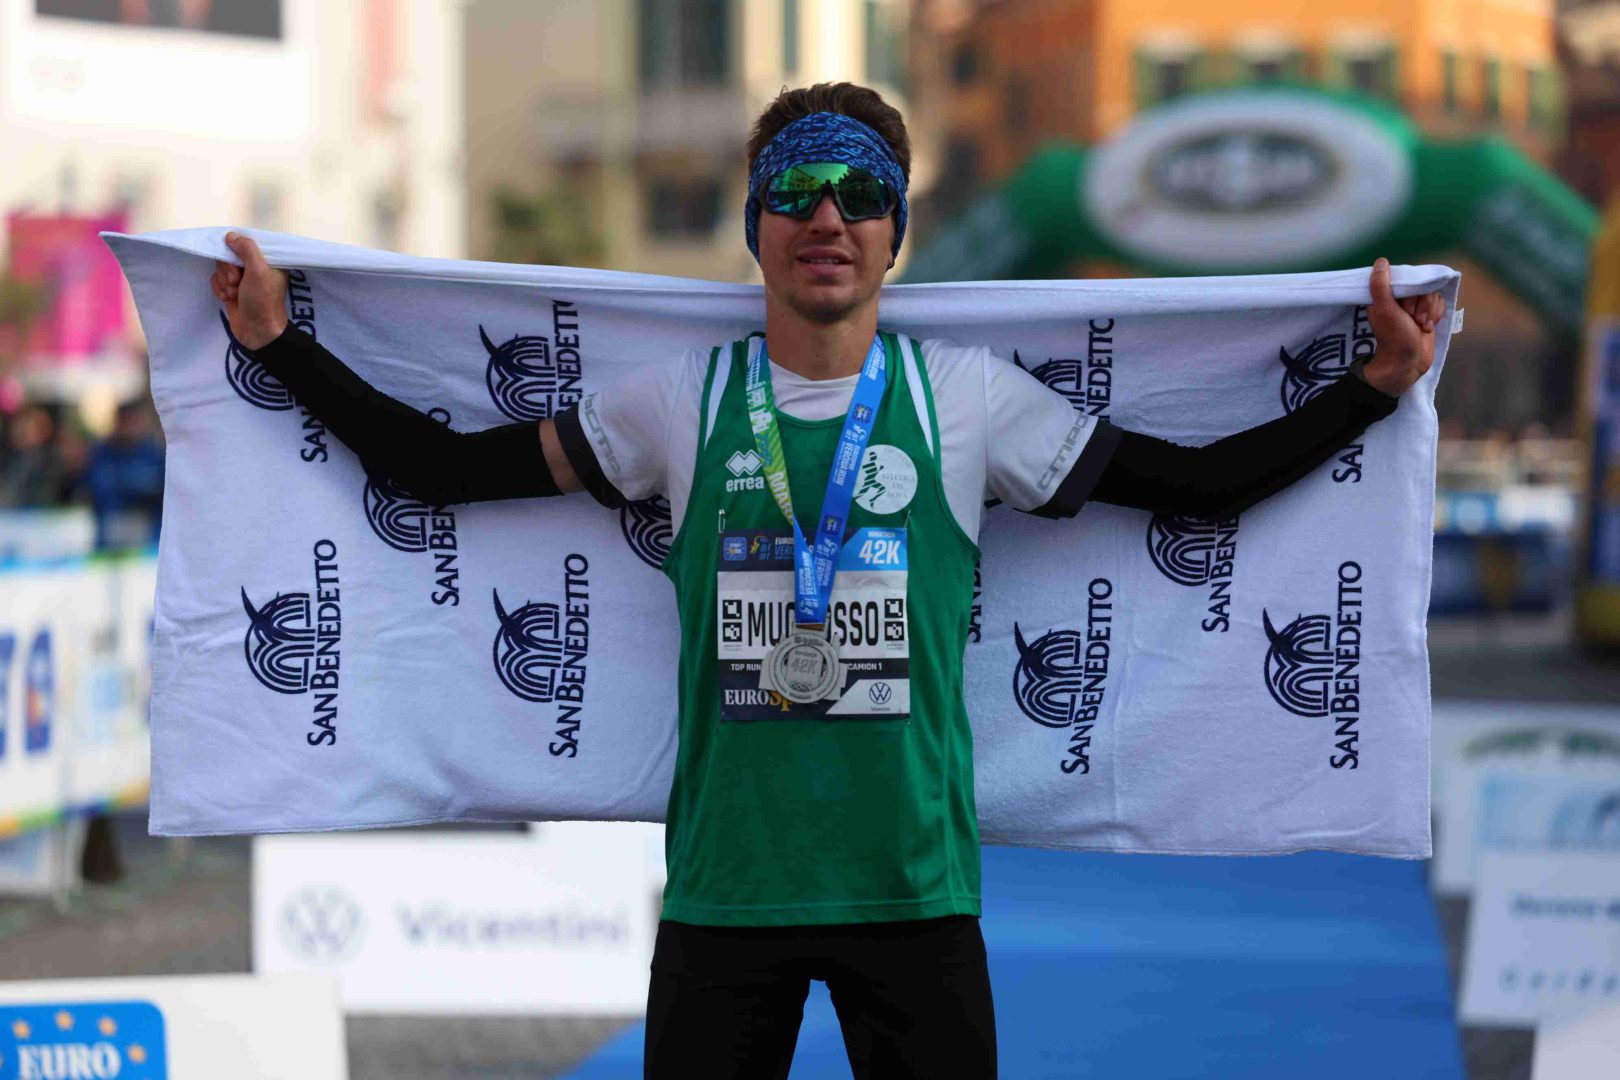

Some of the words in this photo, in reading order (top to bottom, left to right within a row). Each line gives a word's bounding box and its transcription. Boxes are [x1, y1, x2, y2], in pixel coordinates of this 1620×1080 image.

[553, 299, 583, 415] ENEDETT
[726, 477, 765, 492] errea
[1332, 445, 1363, 483] SA
[859, 540, 901, 564] 42K
[431, 554, 460, 607] SAN
[1201, 581, 1232, 633] SAN
[310, 539, 342, 690] BENEDETTO
[554, 553, 589, 703] BENEDETTO
[1331, 560, 1362, 714] BENEDETTO
[731, 663, 745, 671] TOP
[746, 663, 761, 671] RUN
[1074, 577, 1113, 724] BENEDETTO
[307, 693, 339, 746] SAN
[549, 704, 583, 758] SAN
[1330, 717, 1360, 769] SAN
[1061, 720, 1095, 774] SAN
[17, 1041, 122, 1080] EURO
